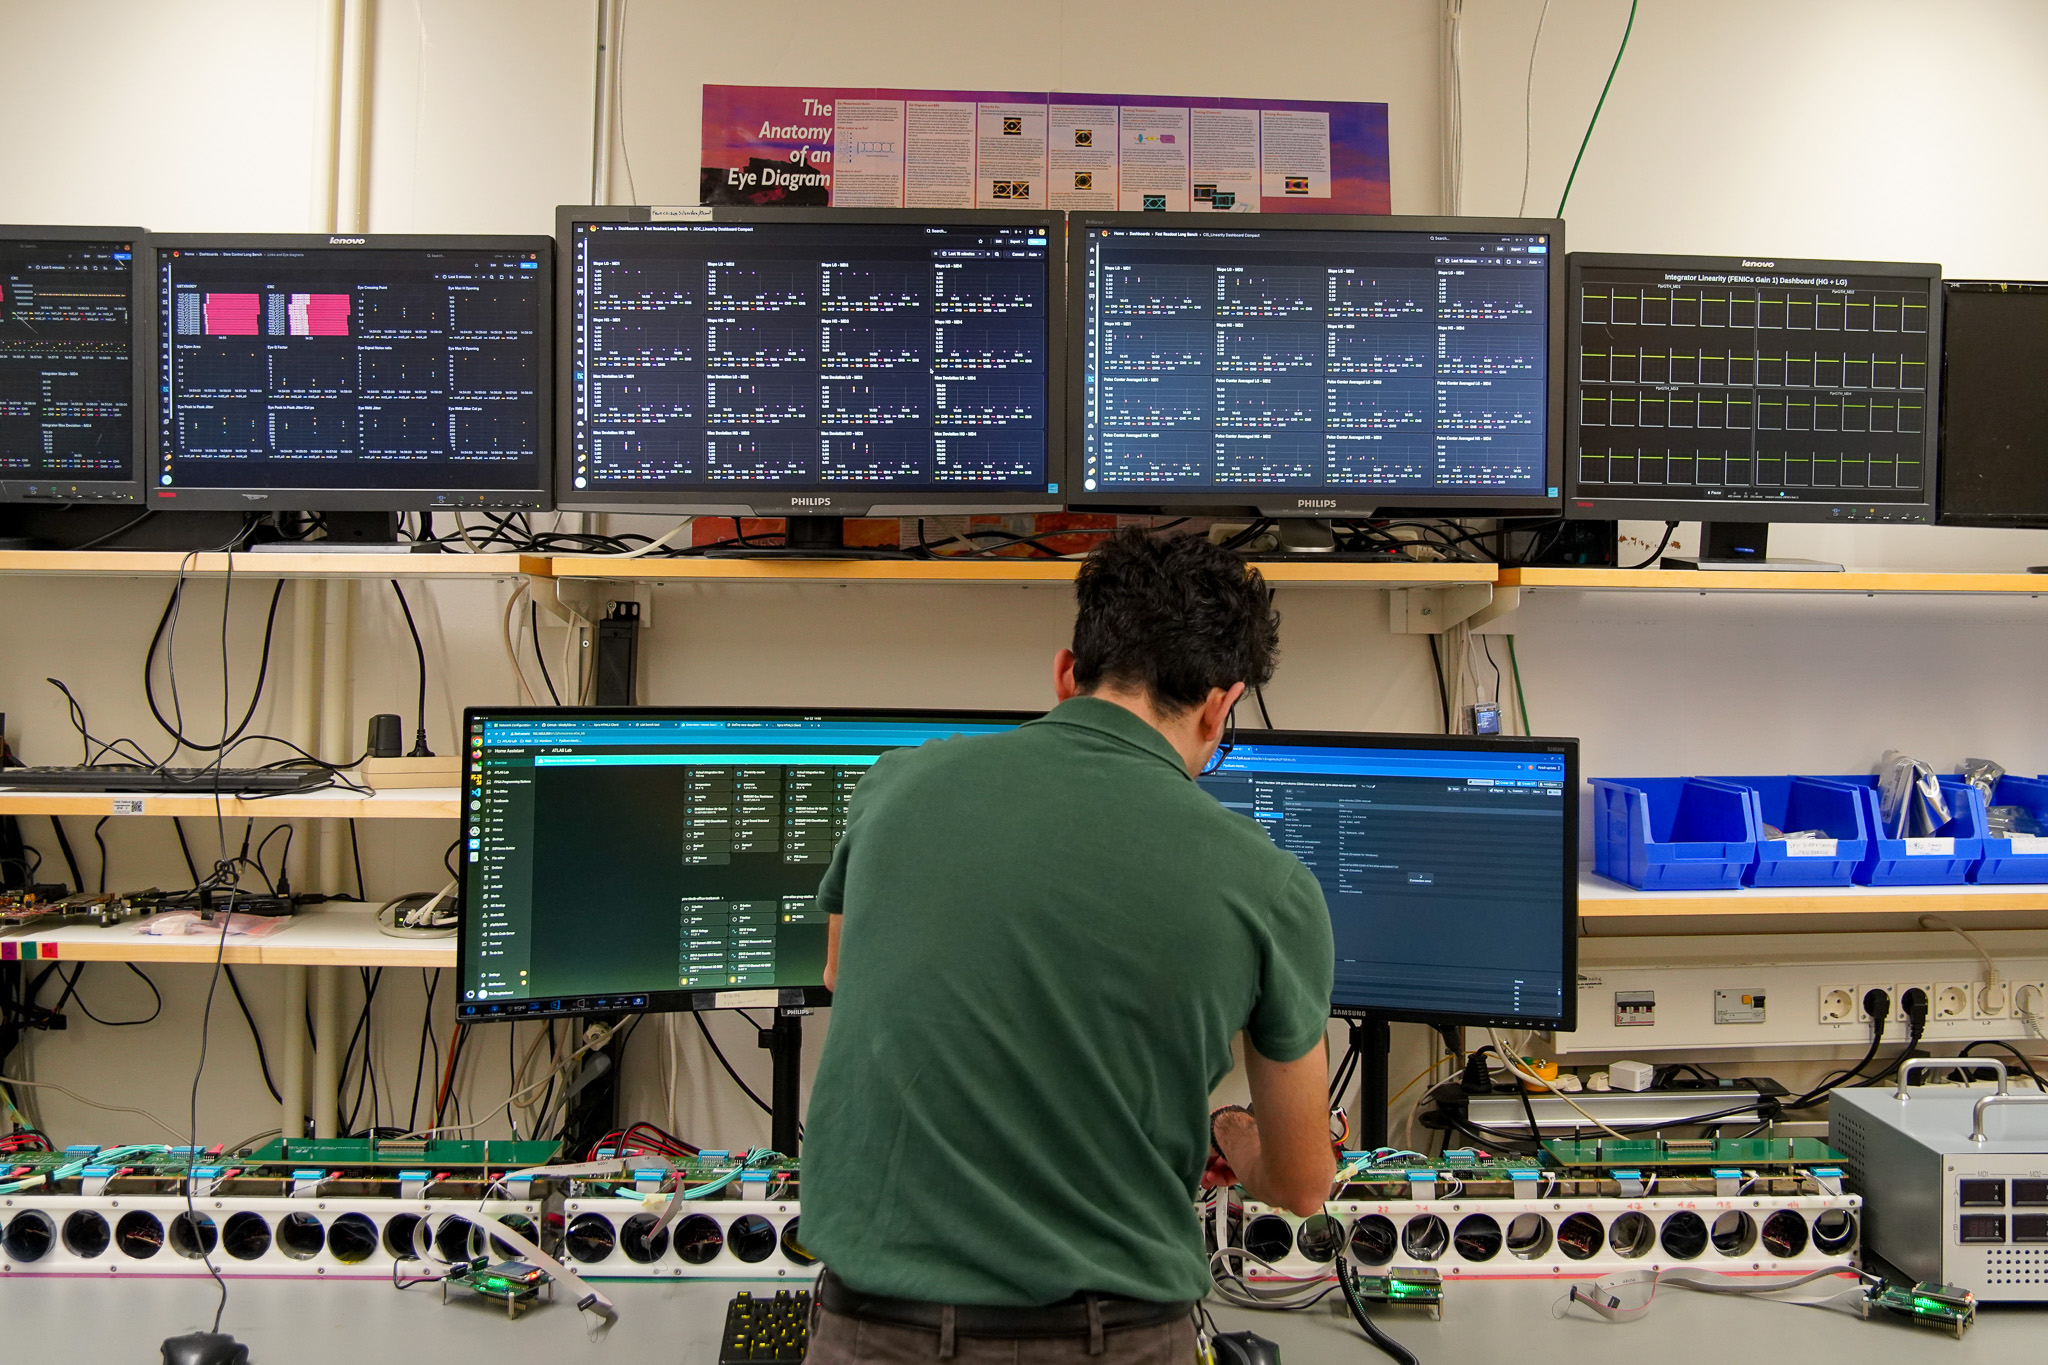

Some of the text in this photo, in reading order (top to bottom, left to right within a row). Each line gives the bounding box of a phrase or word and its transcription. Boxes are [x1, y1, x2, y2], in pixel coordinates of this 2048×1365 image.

[802, 99, 832, 116] The
[759, 121, 832, 144] Anatomy
[790, 146, 831, 166] of an
[728, 168, 756, 190] Eye
[762, 168, 830, 191] Diagram
[1698, 274, 1726, 283] Linearity
[1728, 275, 1753, 283] (FENICs
[791, 498, 831, 506] PHILIPS
[1298, 500, 1336, 508] PHILIPS
[1332, 1009, 1366, 1017] SAMSUNG
